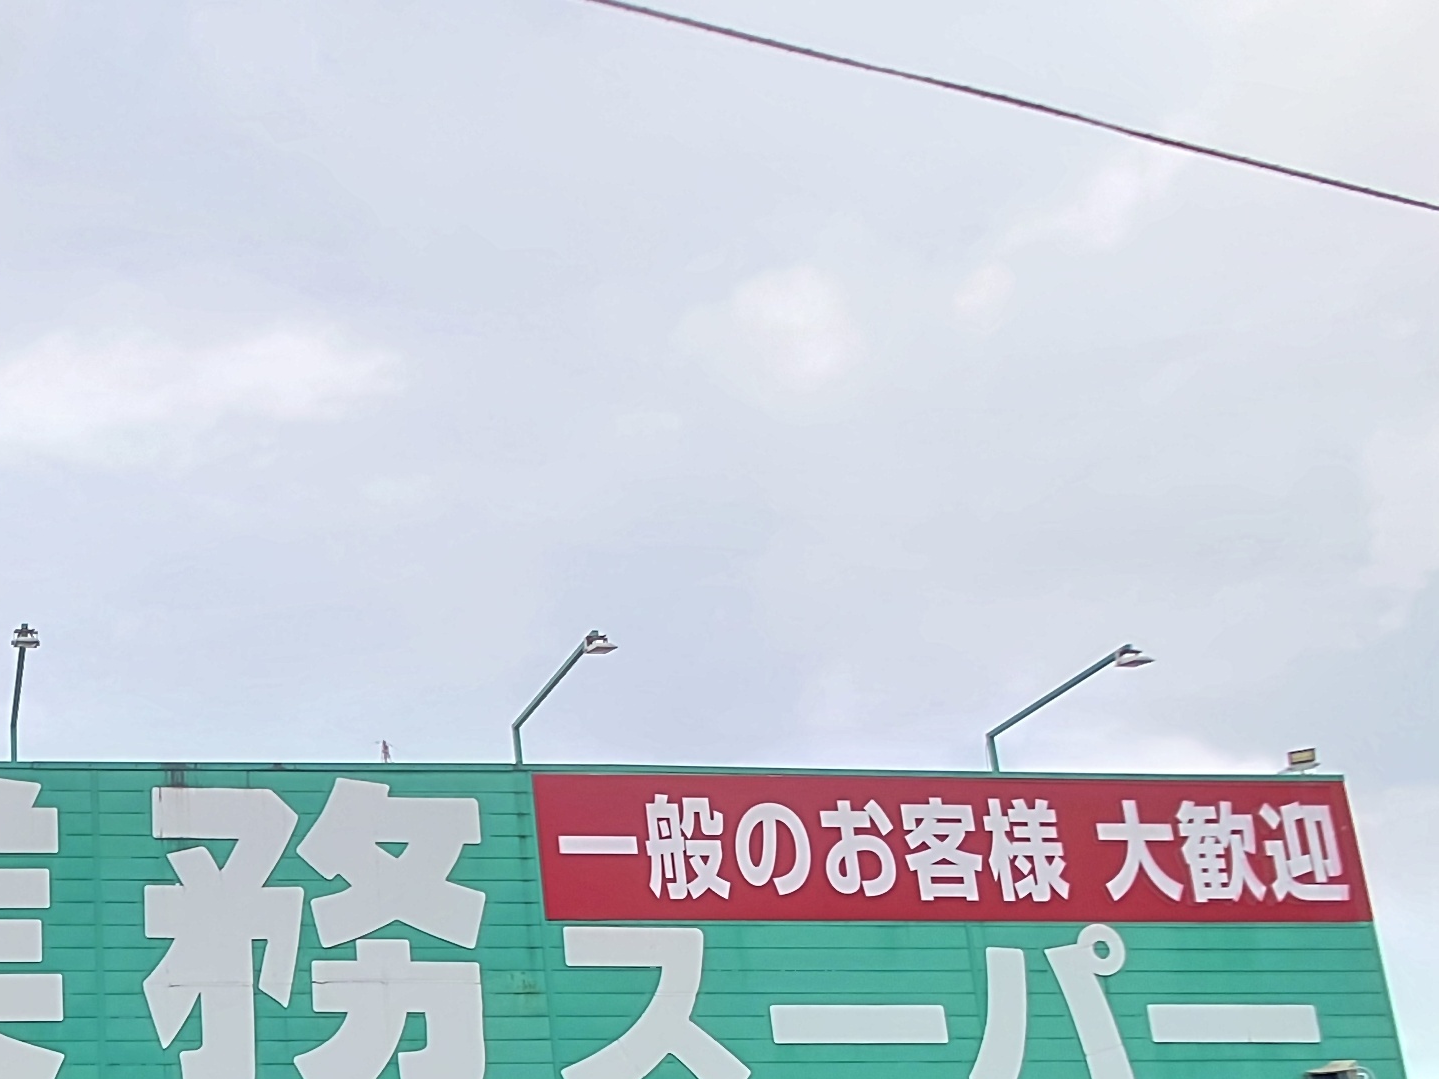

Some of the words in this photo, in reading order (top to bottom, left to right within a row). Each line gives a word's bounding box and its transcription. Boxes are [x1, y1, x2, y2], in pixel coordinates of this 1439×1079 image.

[557, 793, 1071, 904] 一般のお客様
[1096, 799, 1351, 905] 大歓迎
